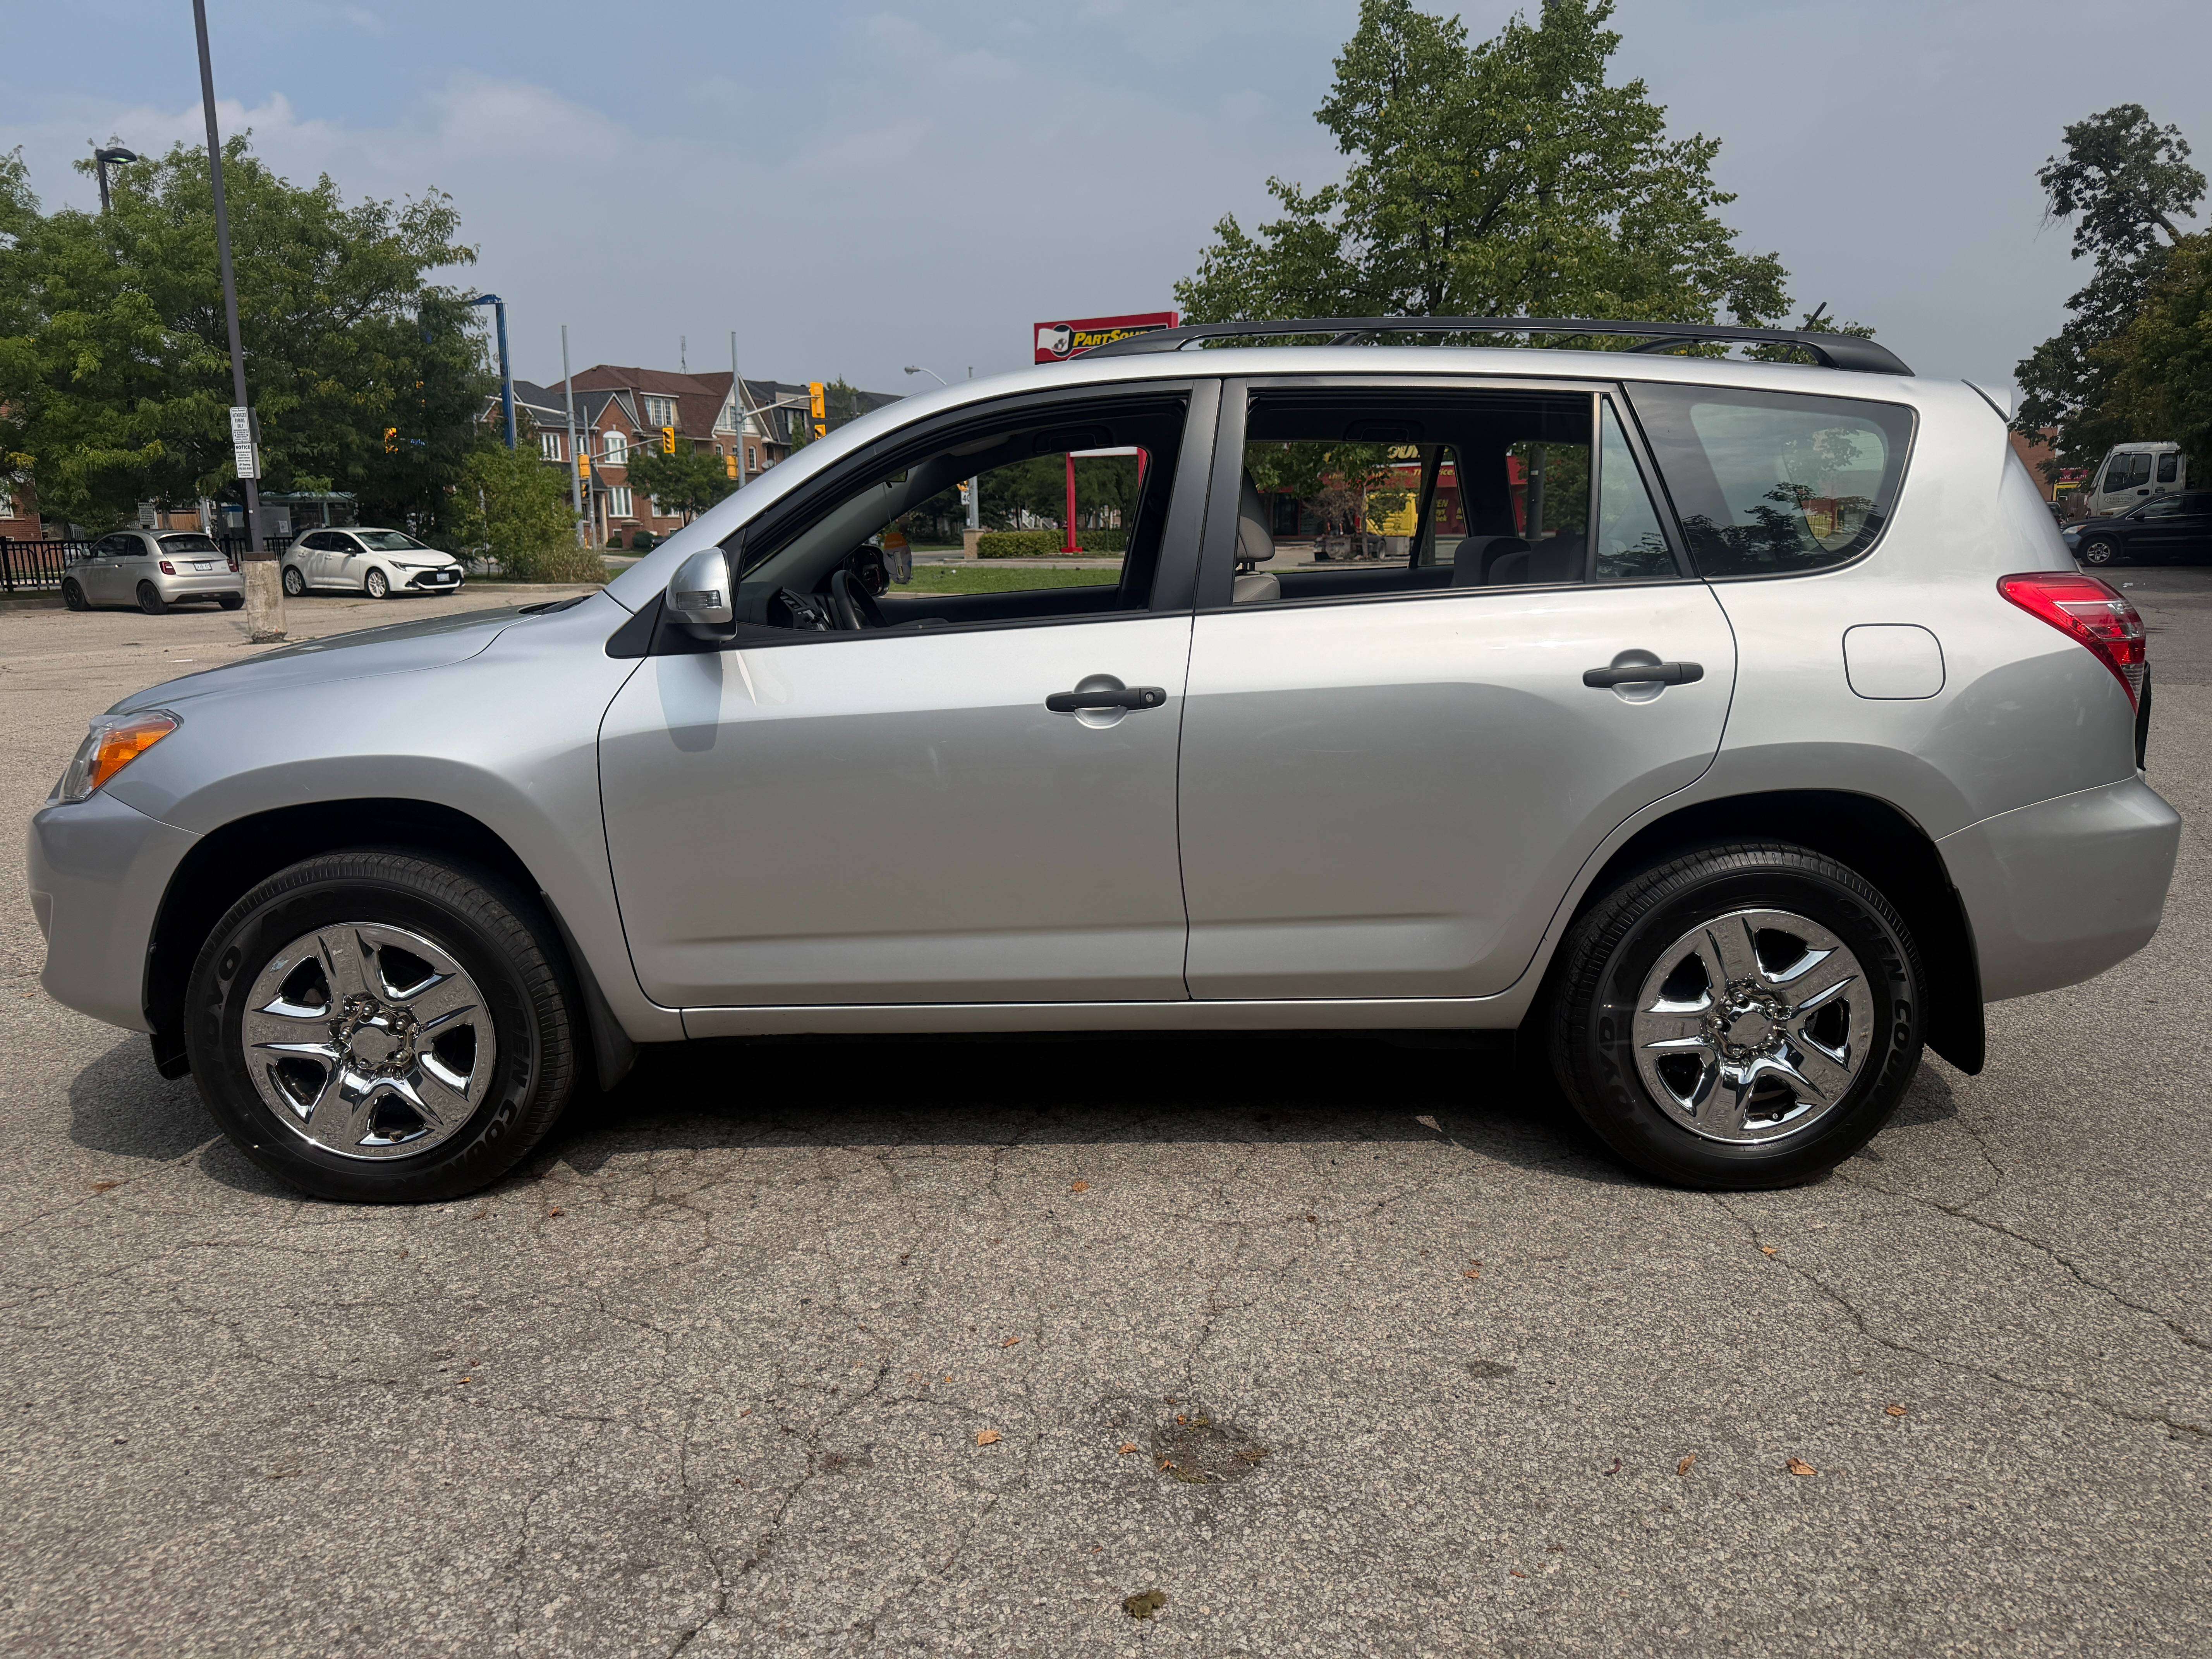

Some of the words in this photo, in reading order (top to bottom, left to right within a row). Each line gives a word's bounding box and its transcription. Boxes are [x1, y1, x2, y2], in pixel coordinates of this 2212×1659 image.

[1837, 898, 1906, 982] OPEN
[494, 979, 529, 1087] OPEN
[1599, 1017, 1651, 1133] TOYO
